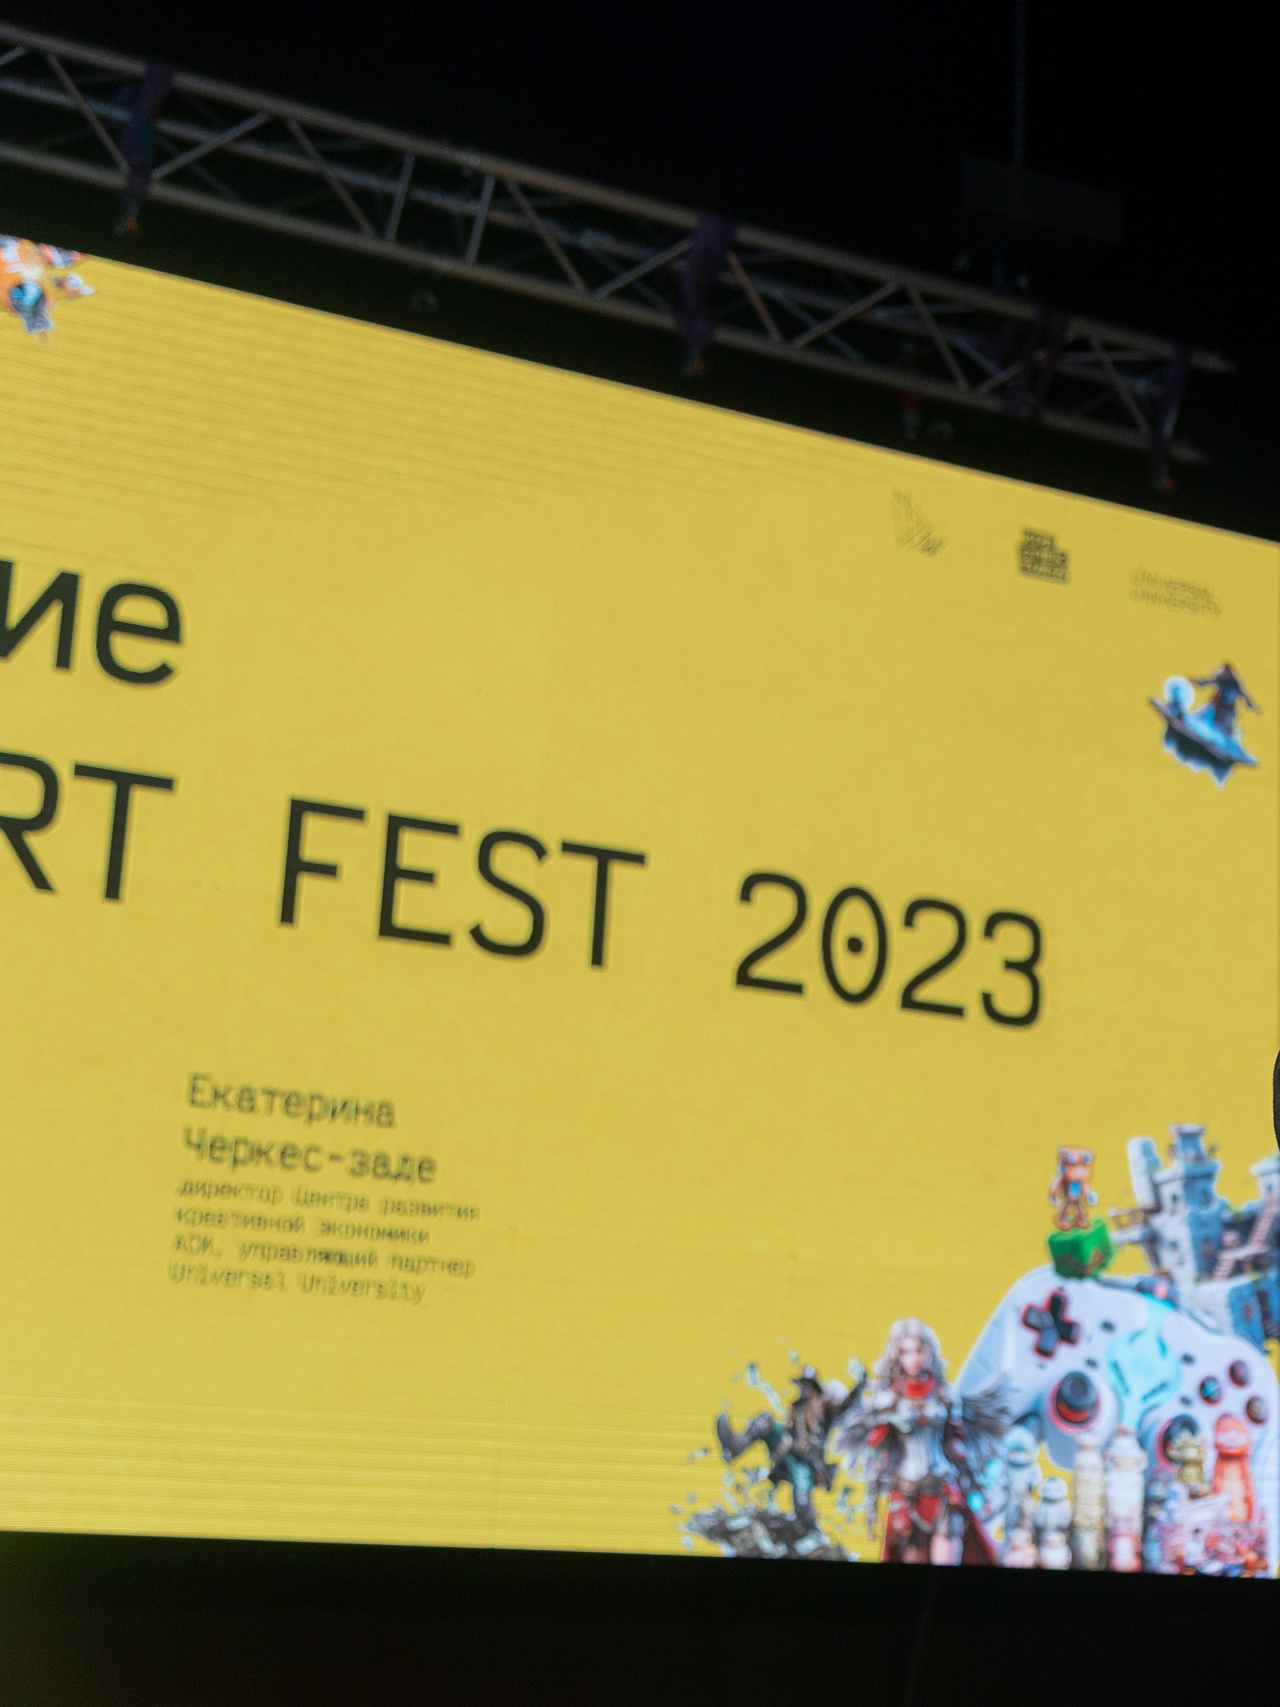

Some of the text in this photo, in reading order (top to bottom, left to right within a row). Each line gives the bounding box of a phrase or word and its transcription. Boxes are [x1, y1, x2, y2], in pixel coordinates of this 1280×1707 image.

[279, 796, 646, 970] FEST
[734, 871, 1043, 1029] 2023
[189, 1073, 396, 1129] Екатерина
[184, 1124, 437, 1185] Черкес-заде
[169, 1261, 427, 1305] Universal University
